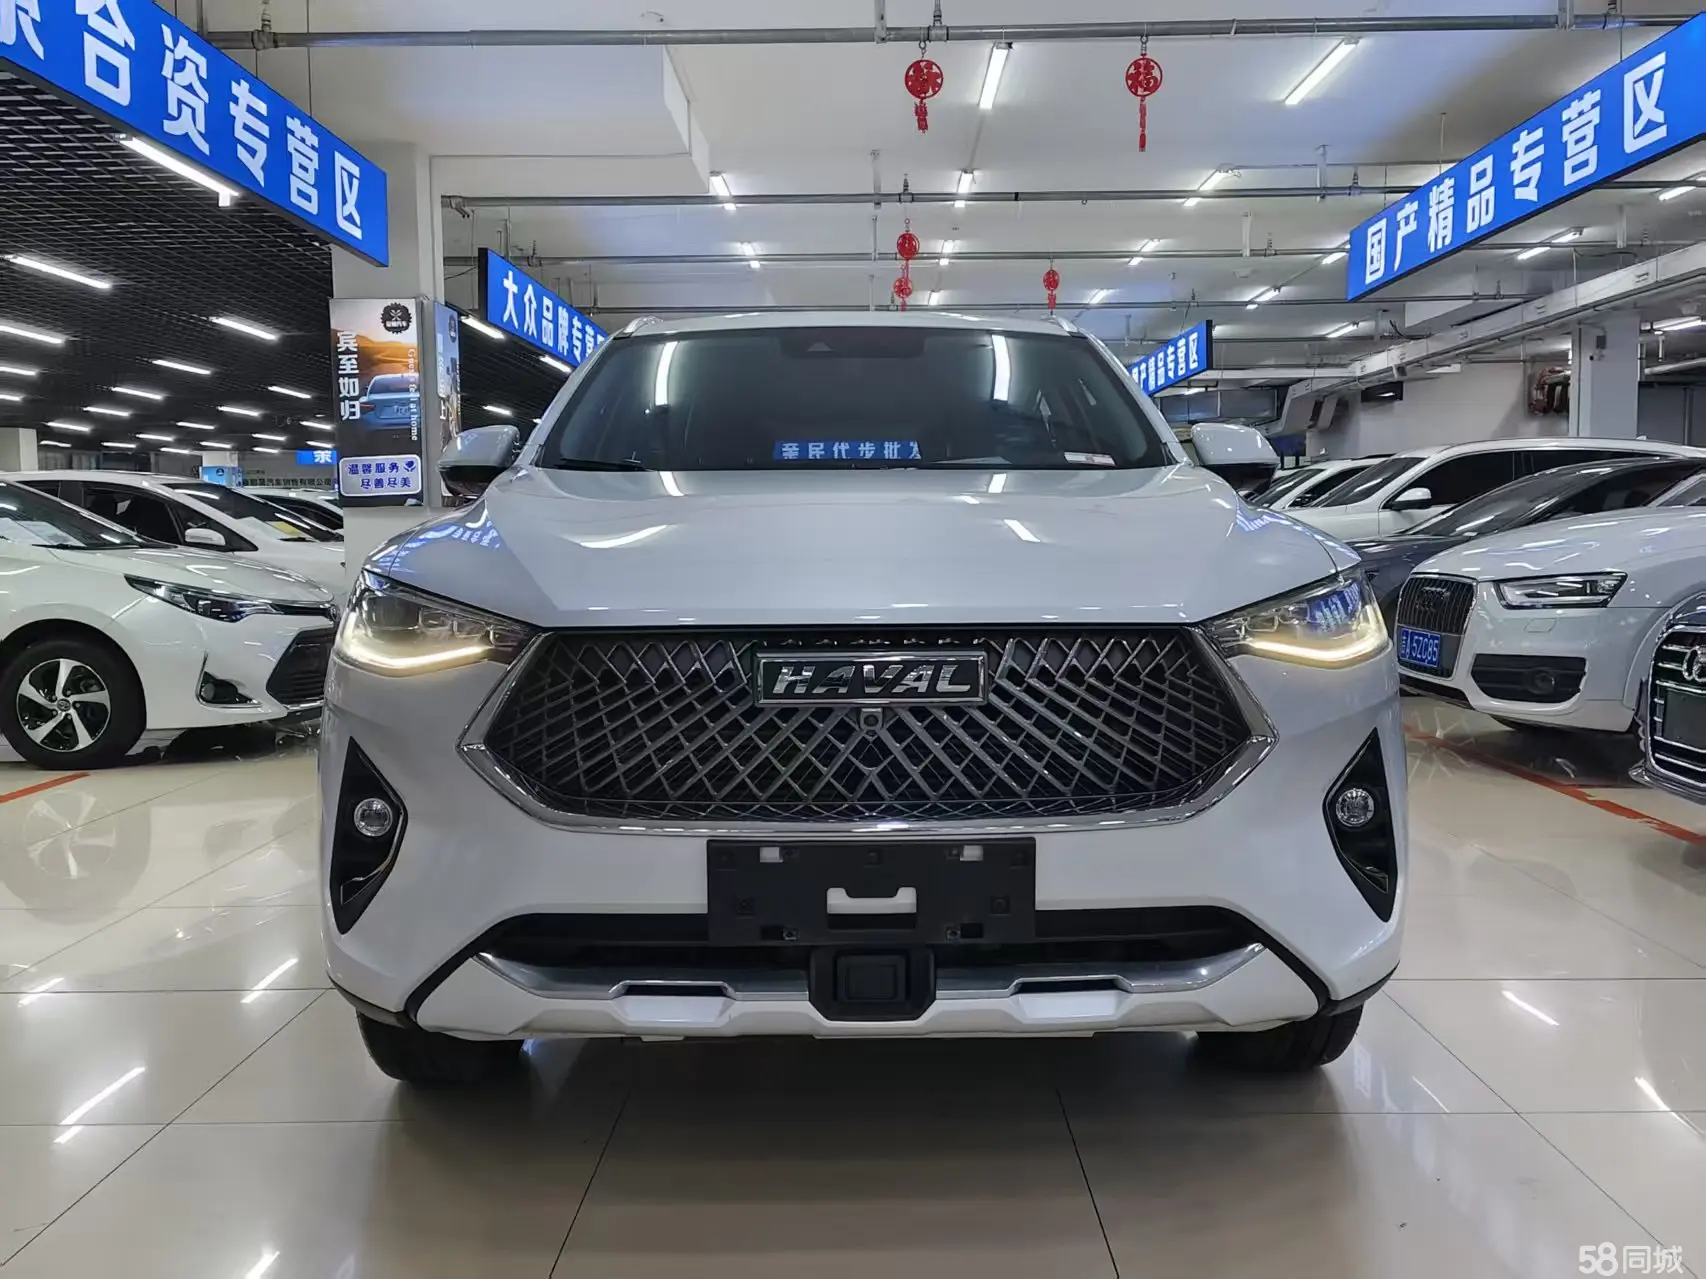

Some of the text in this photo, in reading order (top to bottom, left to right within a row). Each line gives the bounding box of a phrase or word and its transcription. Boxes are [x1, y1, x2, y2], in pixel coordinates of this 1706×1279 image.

[1365, 50, 1668, 285] 国产精品专营区
[503, 270, 605, 364] 大众品牌专营
[336, 331, 361, 421] 宾至如归
[347, 462, 400, 475] 温馨服务
[360, 477, 412, 490] 尽善尽美
[772, 664, 972, 695] HAVAL
